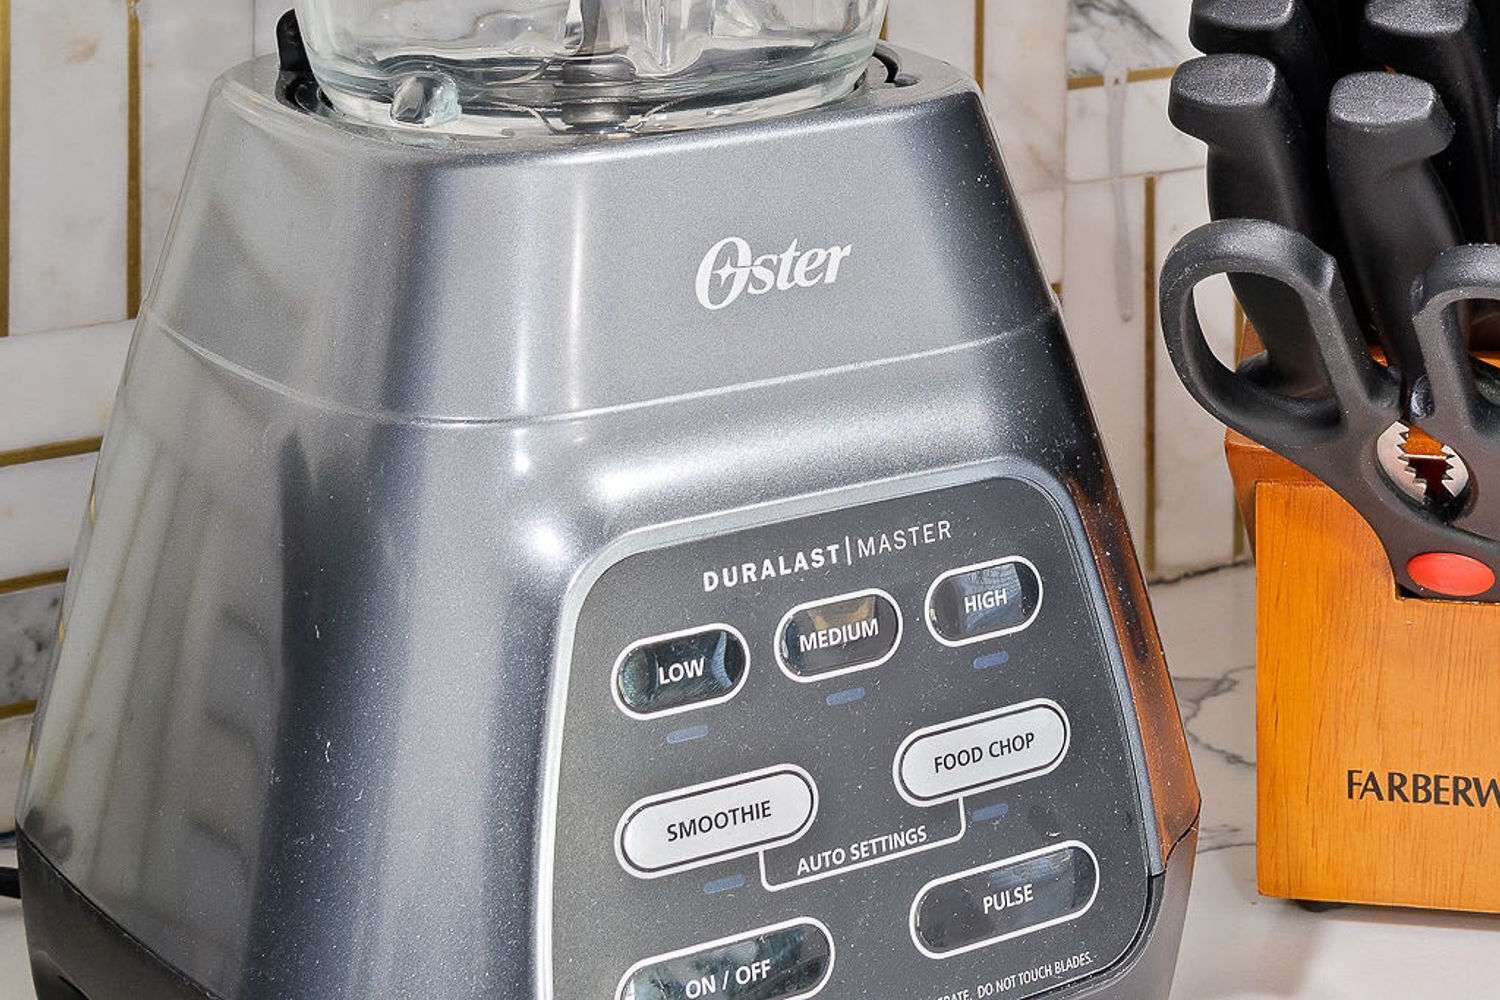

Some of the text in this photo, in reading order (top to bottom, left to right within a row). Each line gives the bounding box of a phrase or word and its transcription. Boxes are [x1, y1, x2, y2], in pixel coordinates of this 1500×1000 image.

[695, 236, 852, 310] Oster
[702, 520, 952, 592] DURALAST MASTER
[964, 589, 1008, 614] HIGH
[800, 618, 879, 652] MEDIUM
[659, 657, 705, 685] LOW
[934, 732, 1036, 774] FOOD CHOP
[666, 800, 773, 842] SMOOTHIE
[796, 825, 928, 876] AUTO SETTINGS
[983, 884, 1034, 914] PULSE
[685, 959, 772, 999] ON / OFF
[977, 982, 994, 999] DO
[995, 974, 1017, 993] NOT
[1018, 963, 1052, 986] TOUCH
[1054, 951, 1094, 974] BLADES.
